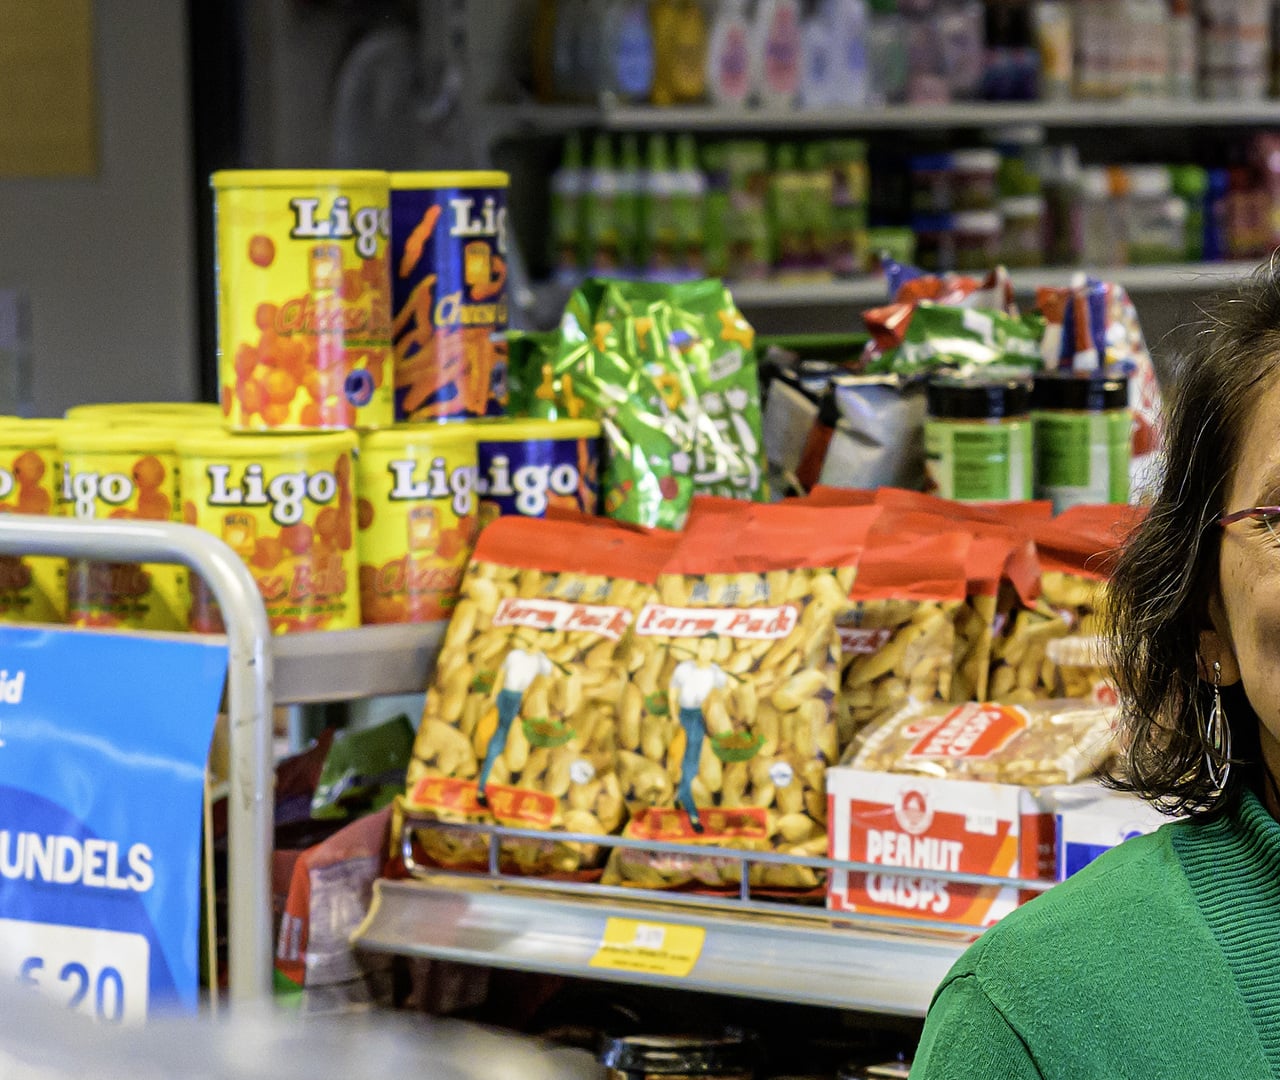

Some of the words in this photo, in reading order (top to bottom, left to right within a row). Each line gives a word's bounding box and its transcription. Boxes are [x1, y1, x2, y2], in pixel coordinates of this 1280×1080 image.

[61, 462, 133, 520] igo
[208, 464, 336, 525] Ligo
[390, 459, 477, 515] Lig
[479, 456, 579, 515] igo
[641, 609, 713, 635] Farm
[724, 612, 789, 637] Pack
[1, 831, 153, 892] UNDELS
[866, 829, 963, 872] PEANUT
[866, 872, 950, 914] CRISPS
